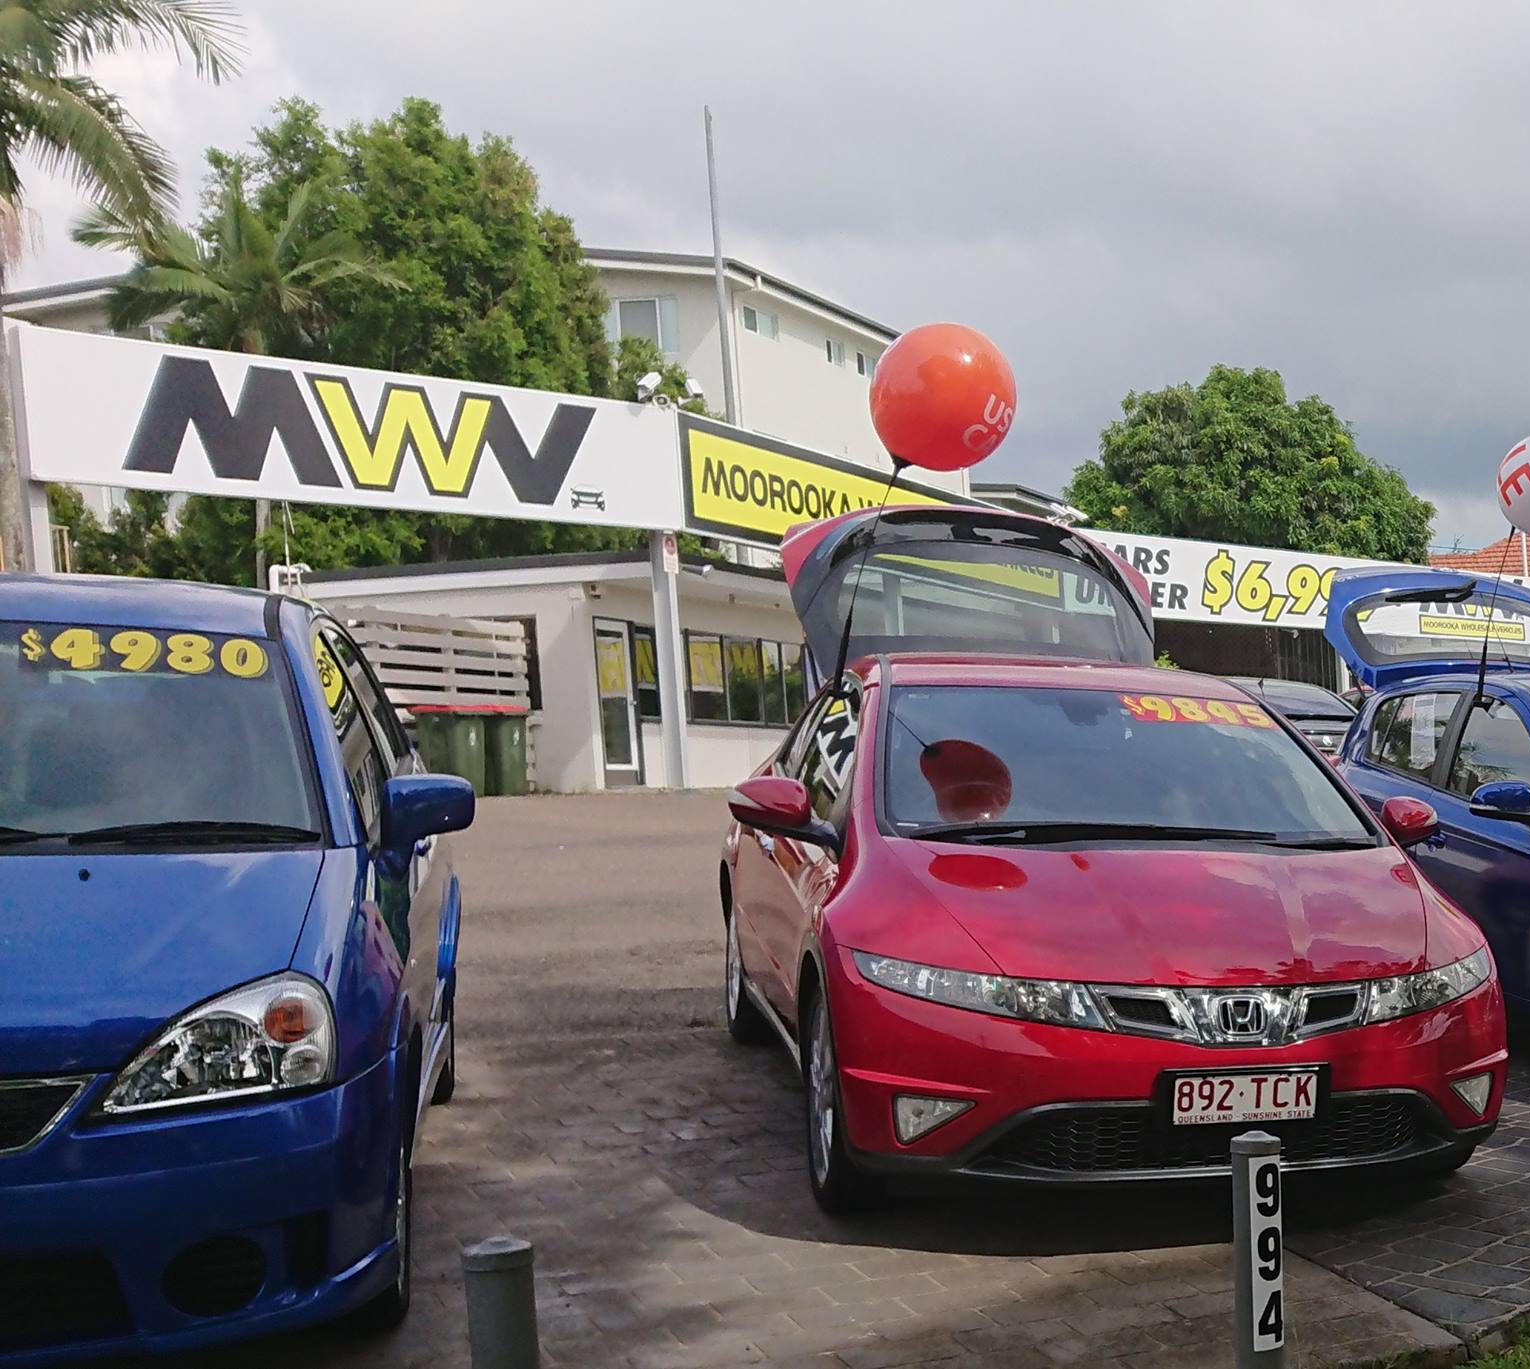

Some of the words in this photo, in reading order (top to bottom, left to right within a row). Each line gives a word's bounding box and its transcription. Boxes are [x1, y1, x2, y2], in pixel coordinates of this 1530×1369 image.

[121, 353, 597, 506] MWV
[701, 457, 851, 519] MOOROOKA
[1100, 543, 1170, 575] ARS
[20, 628, 269, 679] $4980
[1123, 695, 1275, 729] $9845
[1177, 1113, 1233, 1124] QUEENSLAND
[1242, 1110, 1283, 1120] SUNSHINE
[1287, 1109, 1311, 1119] STATE
[1256, 1163, 1283, 1343] 994
